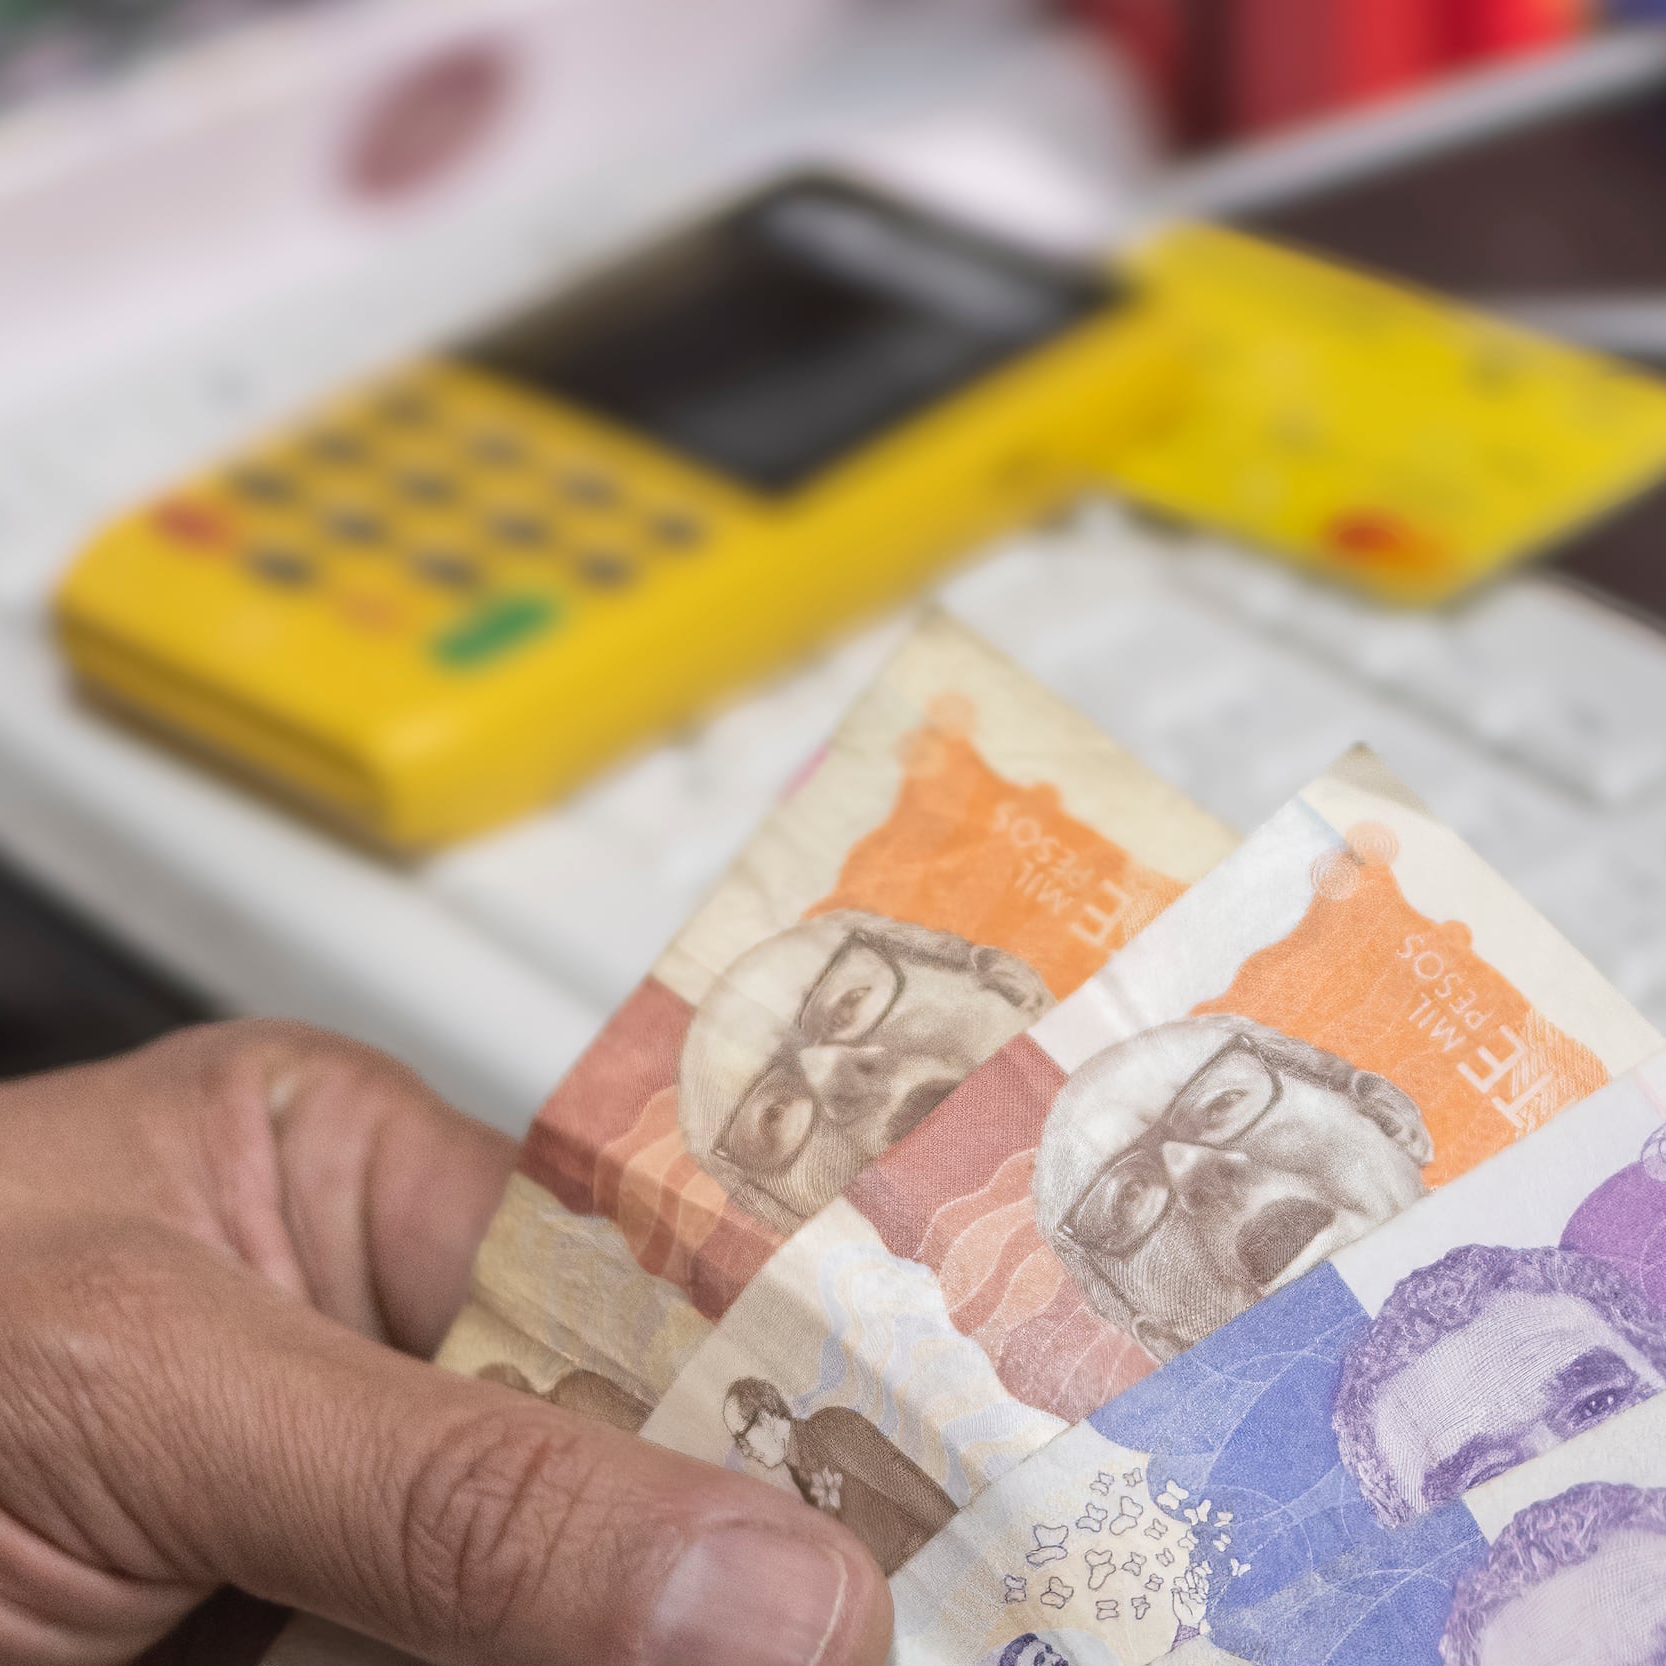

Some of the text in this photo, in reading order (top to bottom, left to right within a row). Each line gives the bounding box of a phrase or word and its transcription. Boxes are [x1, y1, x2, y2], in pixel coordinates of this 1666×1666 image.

[1014, 859, 1075, 915] MIL
[1396, 933, 1493, 1031] PESOS
[1408, 992, 1467, 1053] MIL
